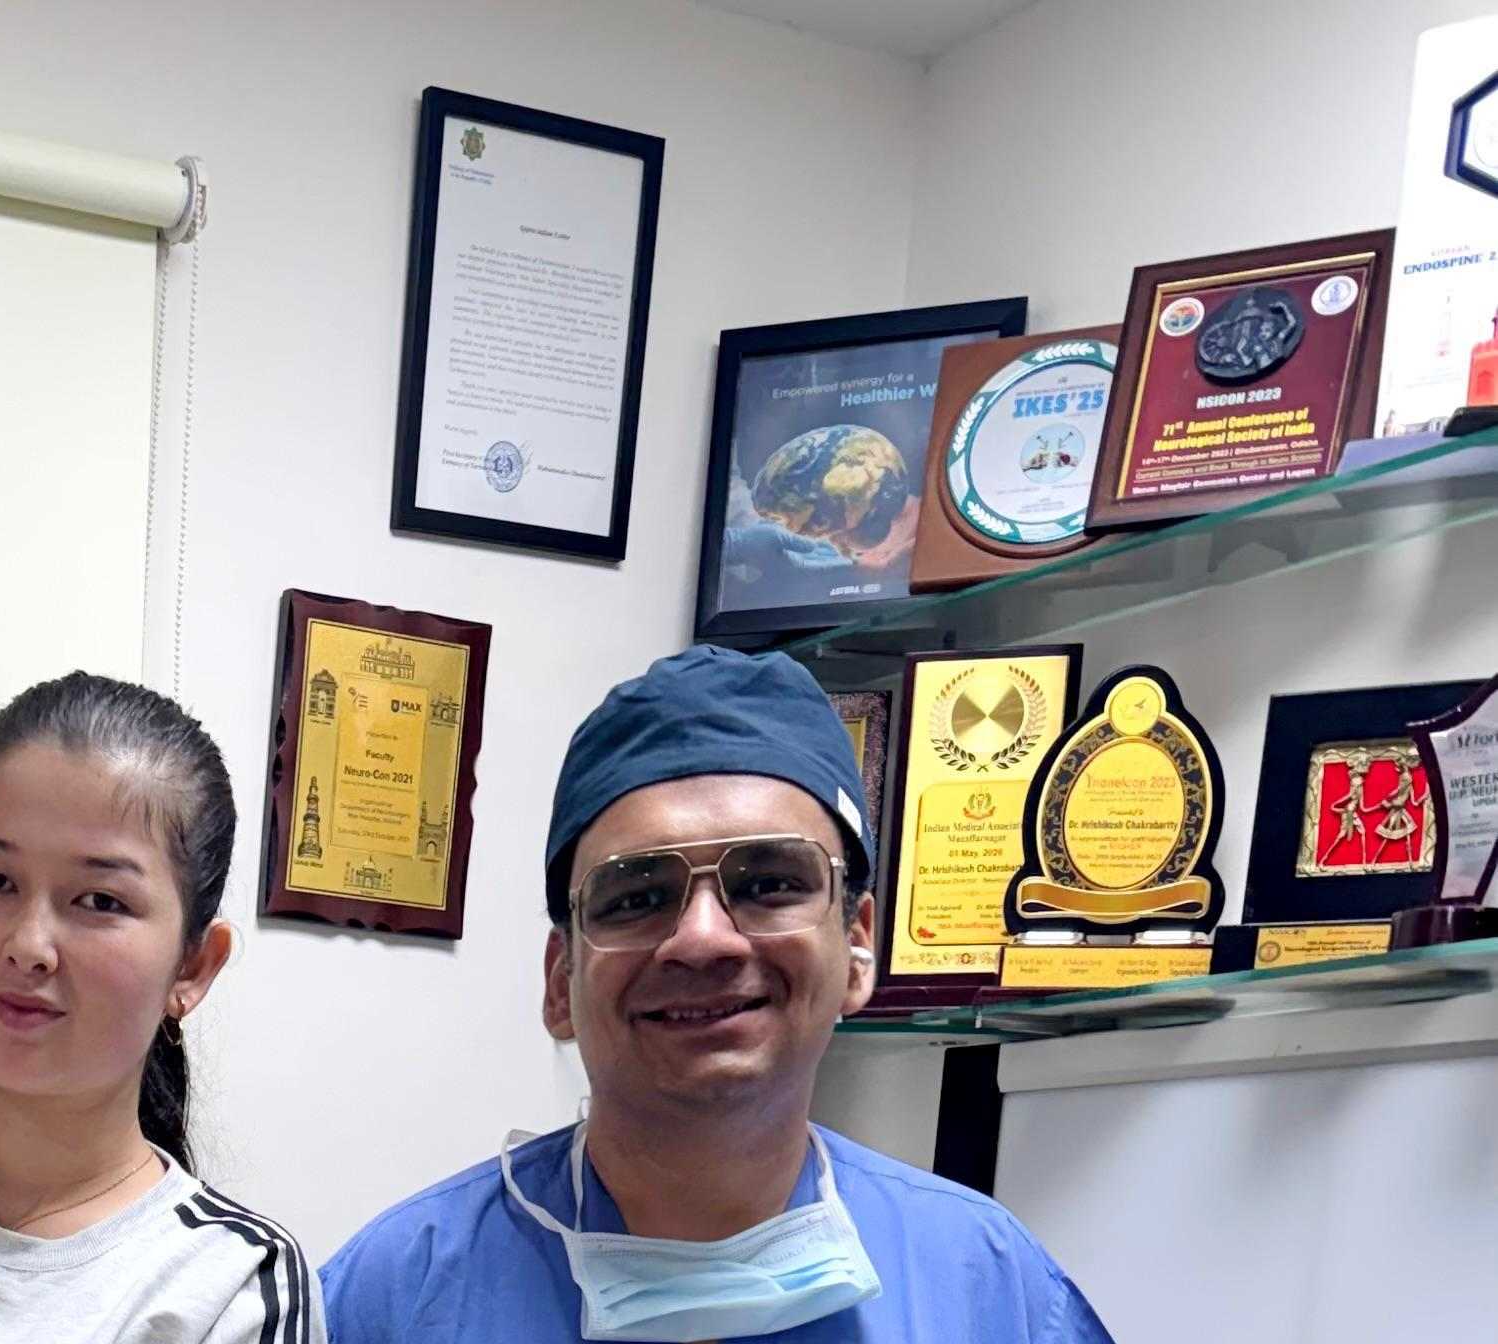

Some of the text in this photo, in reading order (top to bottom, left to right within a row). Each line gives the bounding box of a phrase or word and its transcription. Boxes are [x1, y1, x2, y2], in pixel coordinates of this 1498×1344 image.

[1403, 254, 1483, 275] ENDOSPINE
[772, 371, 914, 400] Empowered synergy for a
[840, 386, 915, 408] Healthier
[1196, 387, 1282, 409] NSICON 2023
[1186, 417, 1227, 434] Annual
[1227, 410, 1295, 429] Conference
[1295, 407, 1310, 420] of
[1153, 421, 1316, 452] Neurological Society of India
[401, 701, 422, 713] MAX
[365, 749, 395, 763] Faculty
[344, 764, 414, 784] Neuro-Con 2021
[924, 823, 950, 833] Indian
[953, 822, 985, 832] Medical
[1080, 820, 1123, 829] Hrishikesh
[932, 864, 975, 874] Hrishikesh
